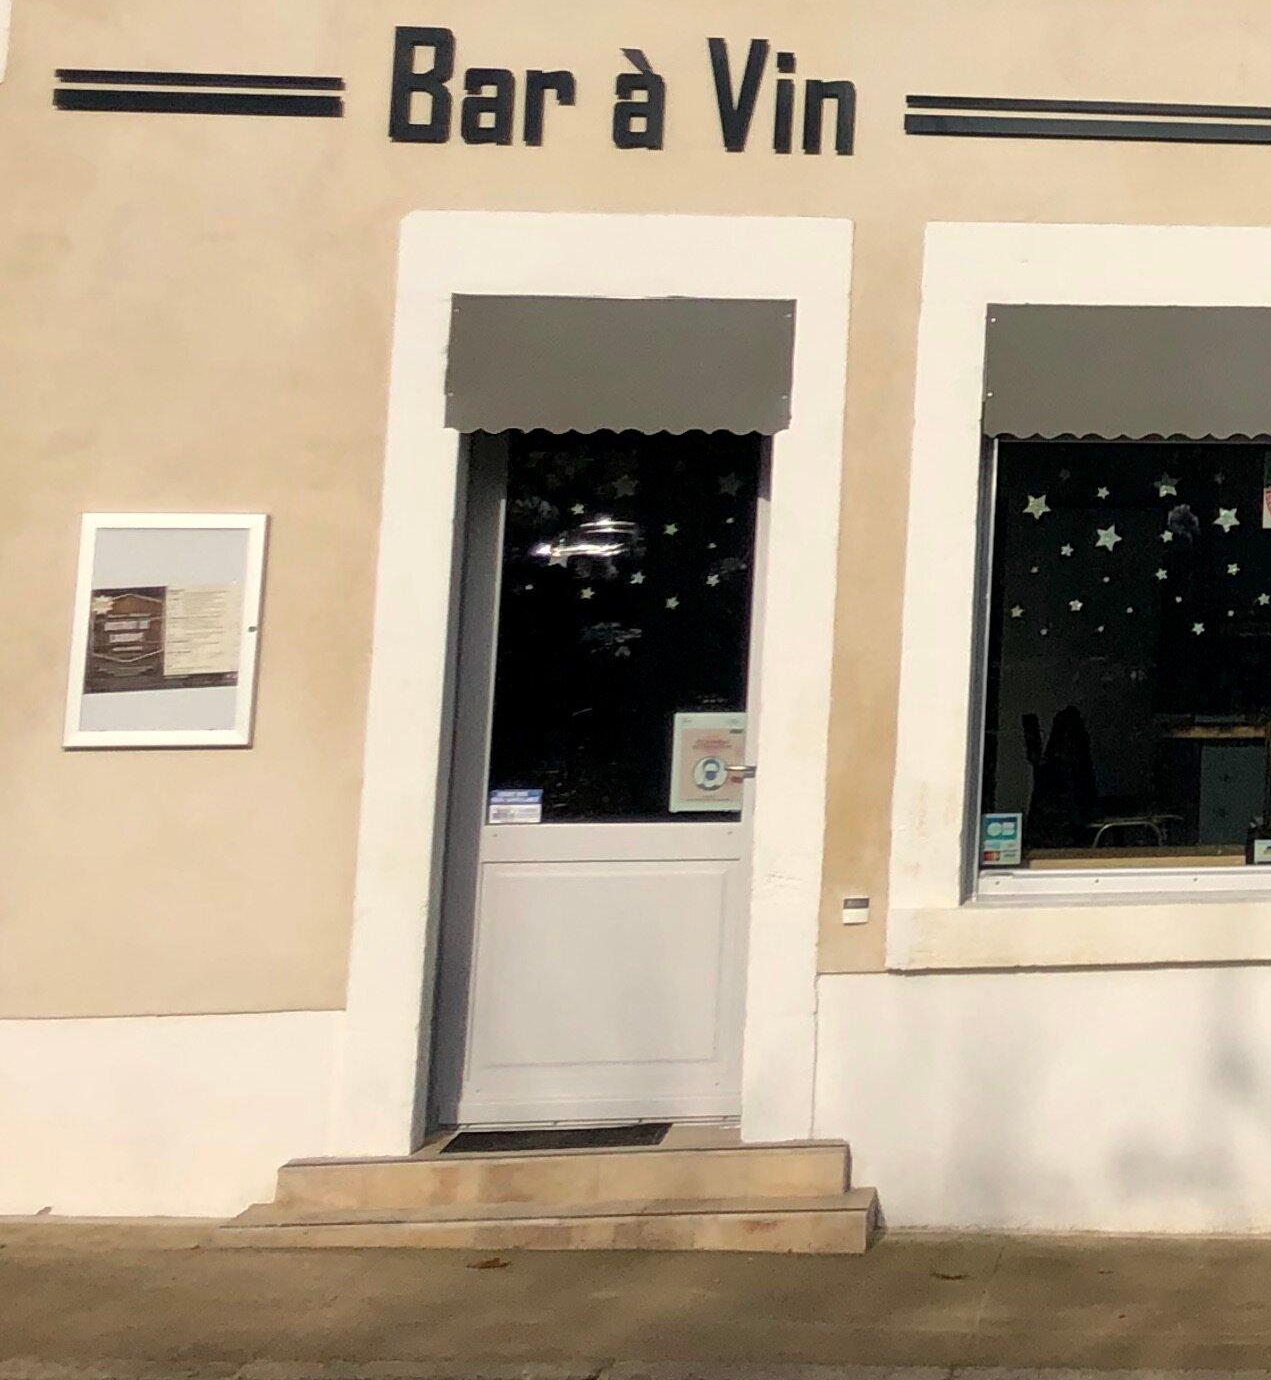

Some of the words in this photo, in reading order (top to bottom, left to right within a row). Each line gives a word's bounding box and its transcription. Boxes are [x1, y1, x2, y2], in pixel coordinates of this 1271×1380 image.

[388, 25, 577, 147] Bar
[612, 47, 666, 150] à
[707, 37, 857, 156] Vin
